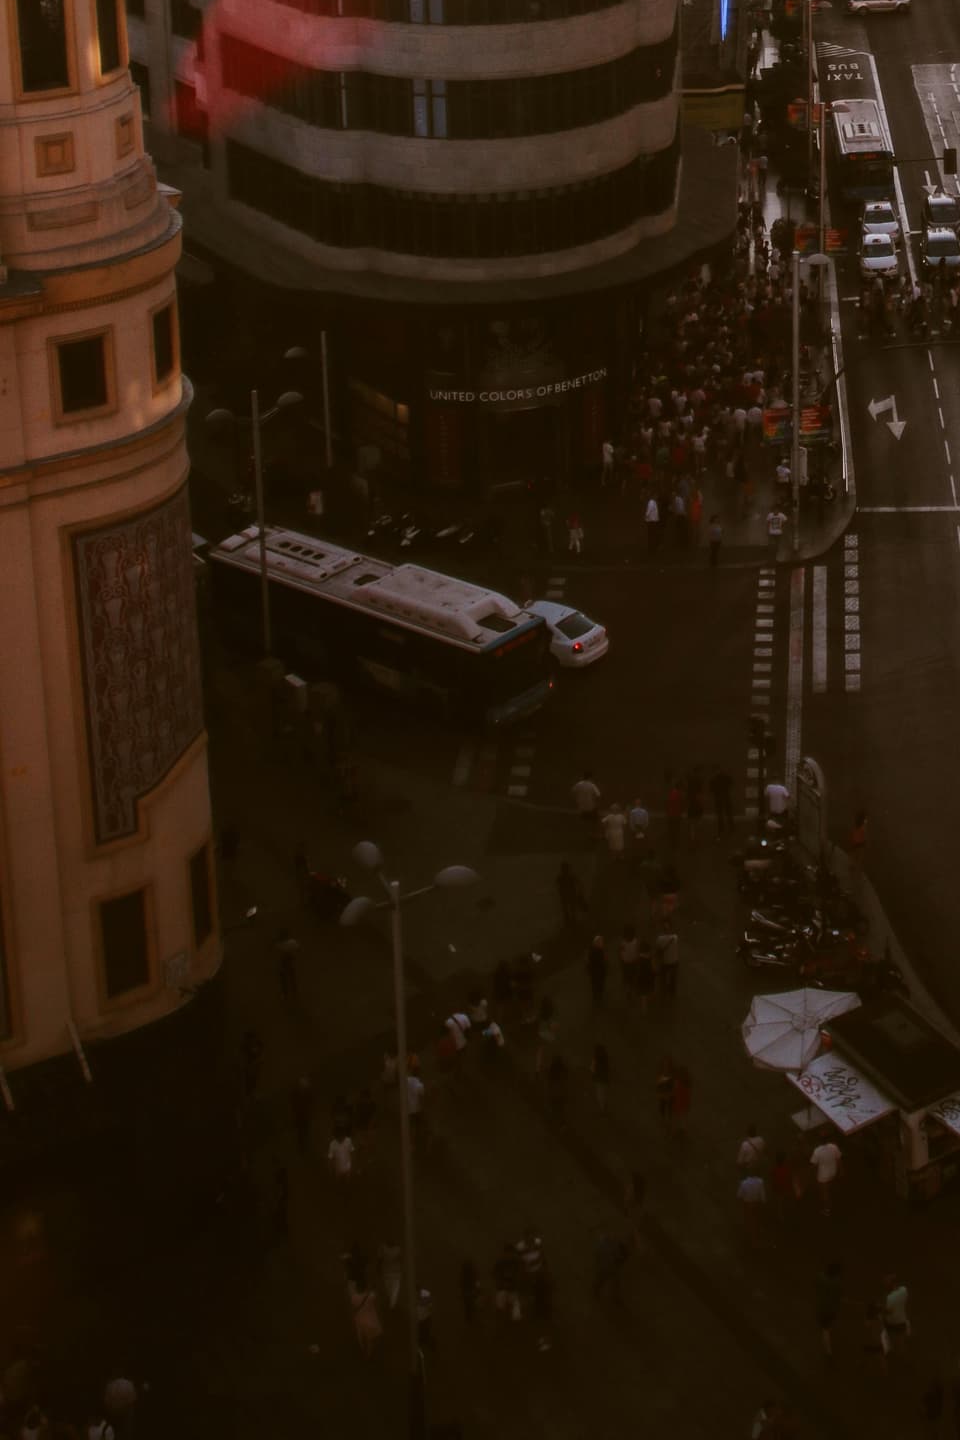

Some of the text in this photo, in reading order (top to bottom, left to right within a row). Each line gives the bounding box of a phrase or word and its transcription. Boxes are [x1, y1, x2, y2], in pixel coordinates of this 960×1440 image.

[827, 62, 859, 71] BUS
[827, 73, 864, 81] TAXI
[429, 367, 608, 403] UNITED COLORS OF BENETTON
